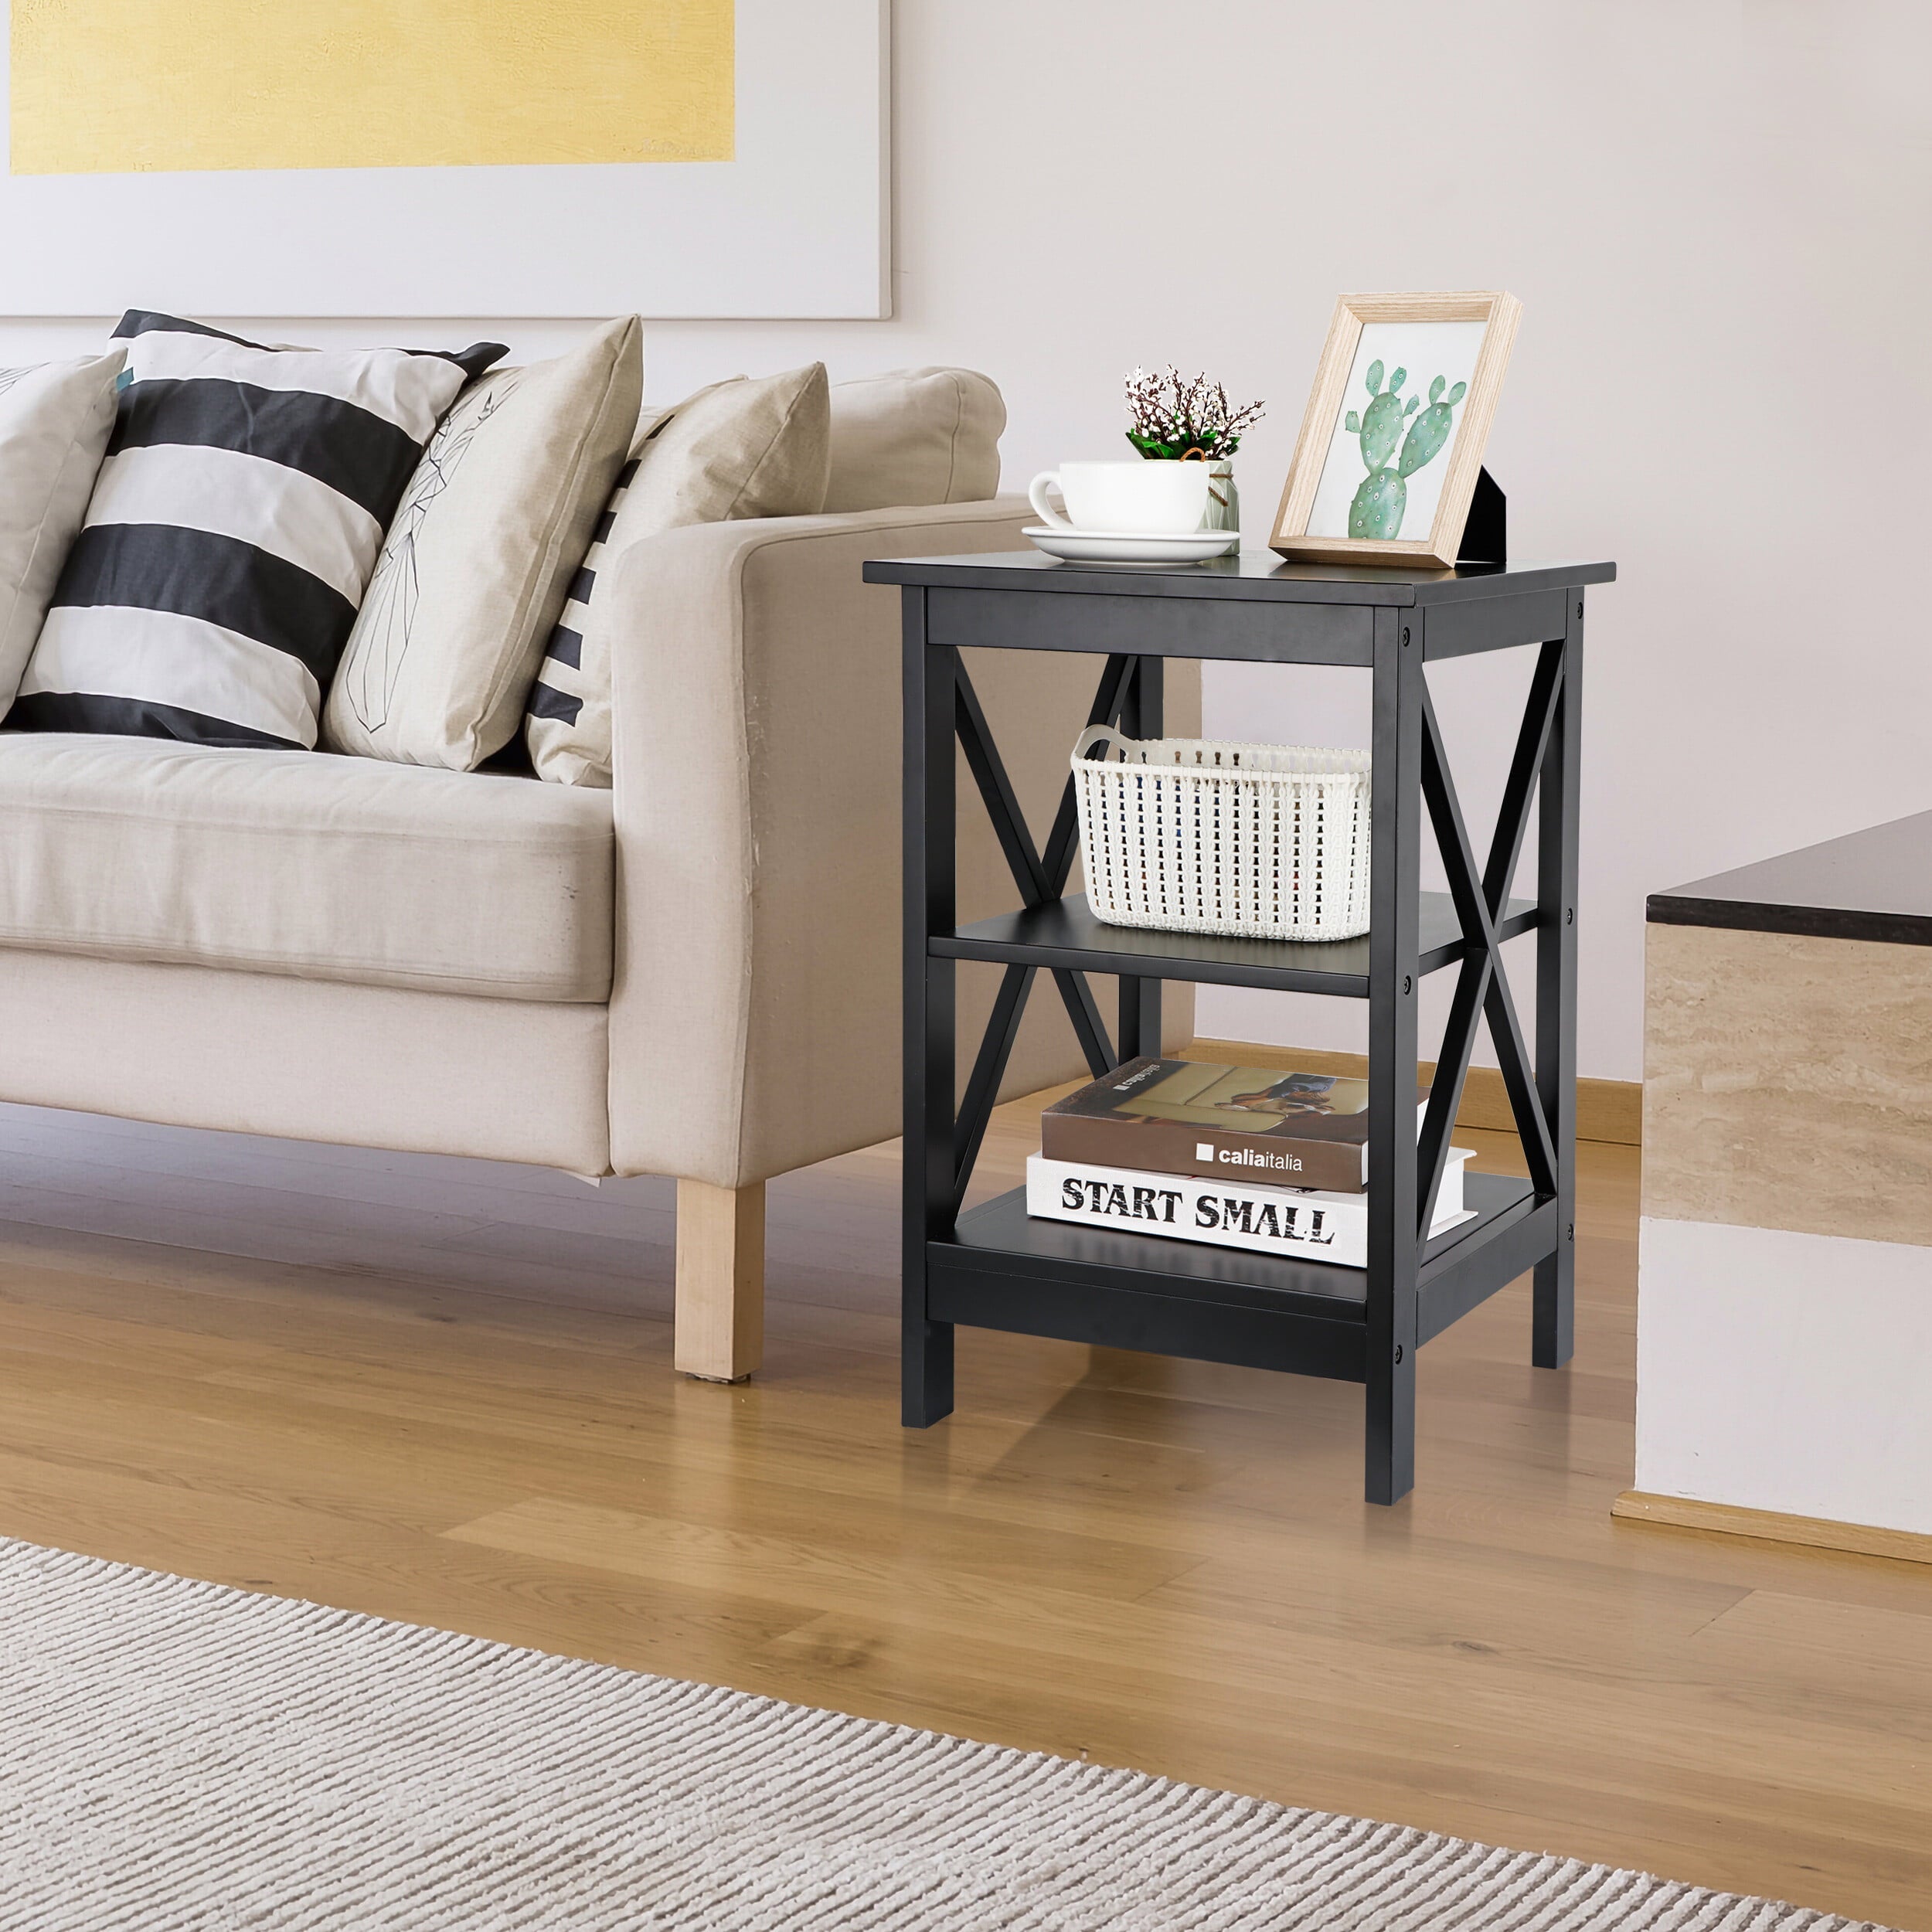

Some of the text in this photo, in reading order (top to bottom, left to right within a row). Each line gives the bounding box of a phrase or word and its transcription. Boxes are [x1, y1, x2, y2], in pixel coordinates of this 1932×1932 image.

[1219, 1148, 1303, 1172] caliaitalia
[1062, 1178, 1335, 1245] START SMALL
